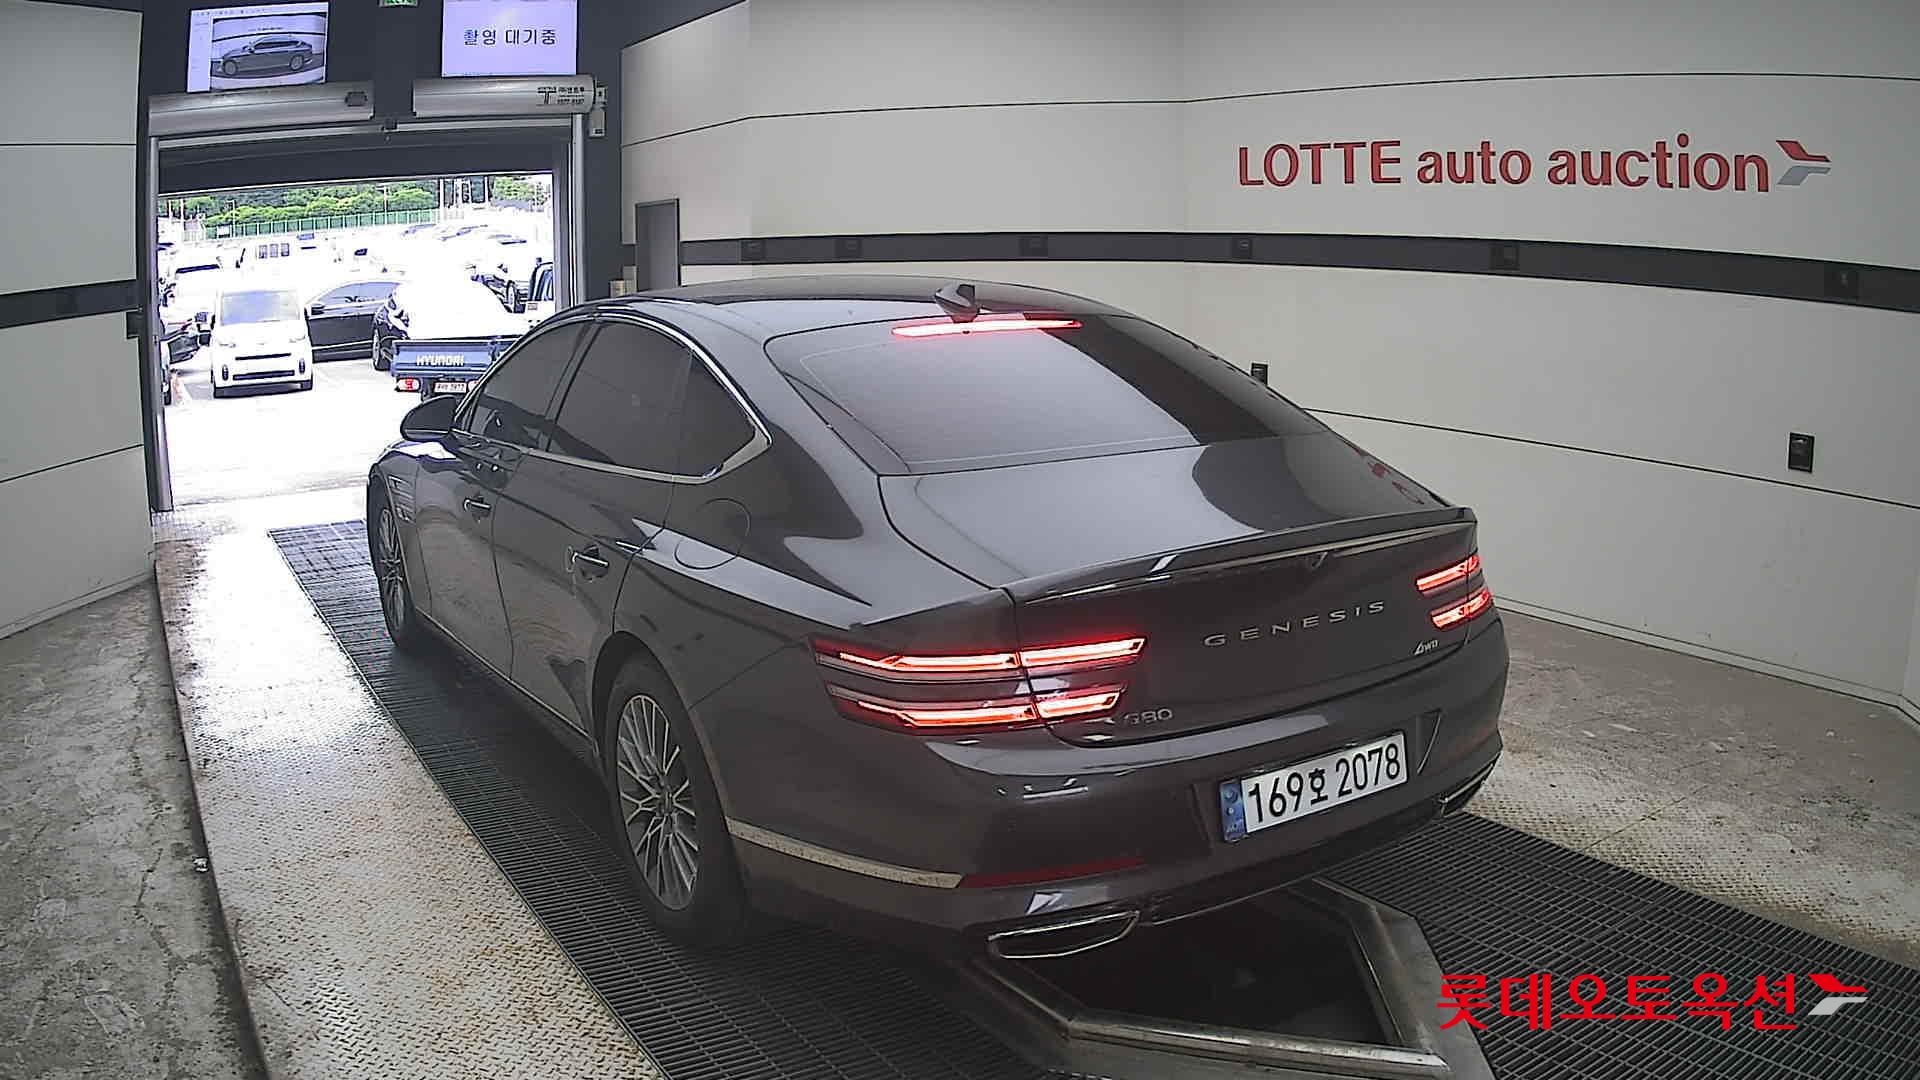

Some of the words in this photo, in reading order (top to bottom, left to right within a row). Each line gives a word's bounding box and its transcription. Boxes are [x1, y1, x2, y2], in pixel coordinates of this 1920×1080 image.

[464, 28, 497, 46] 촬영
[505, 28, 557, 46] 대기중
[1238, 139, 1401, 188] LOTTE
[1416, 140, 1532, 186] auto
[1547, 132, 1770, 193] auction
[416, 354, 465, 367] HYUNDAI
[1203, 600, 1386, 648] GENESIS
[1123, 708, 1173, 726] G80
[1248, 767, 1329, 824] 169호
[1335, 742, 1401, 798] 2078
